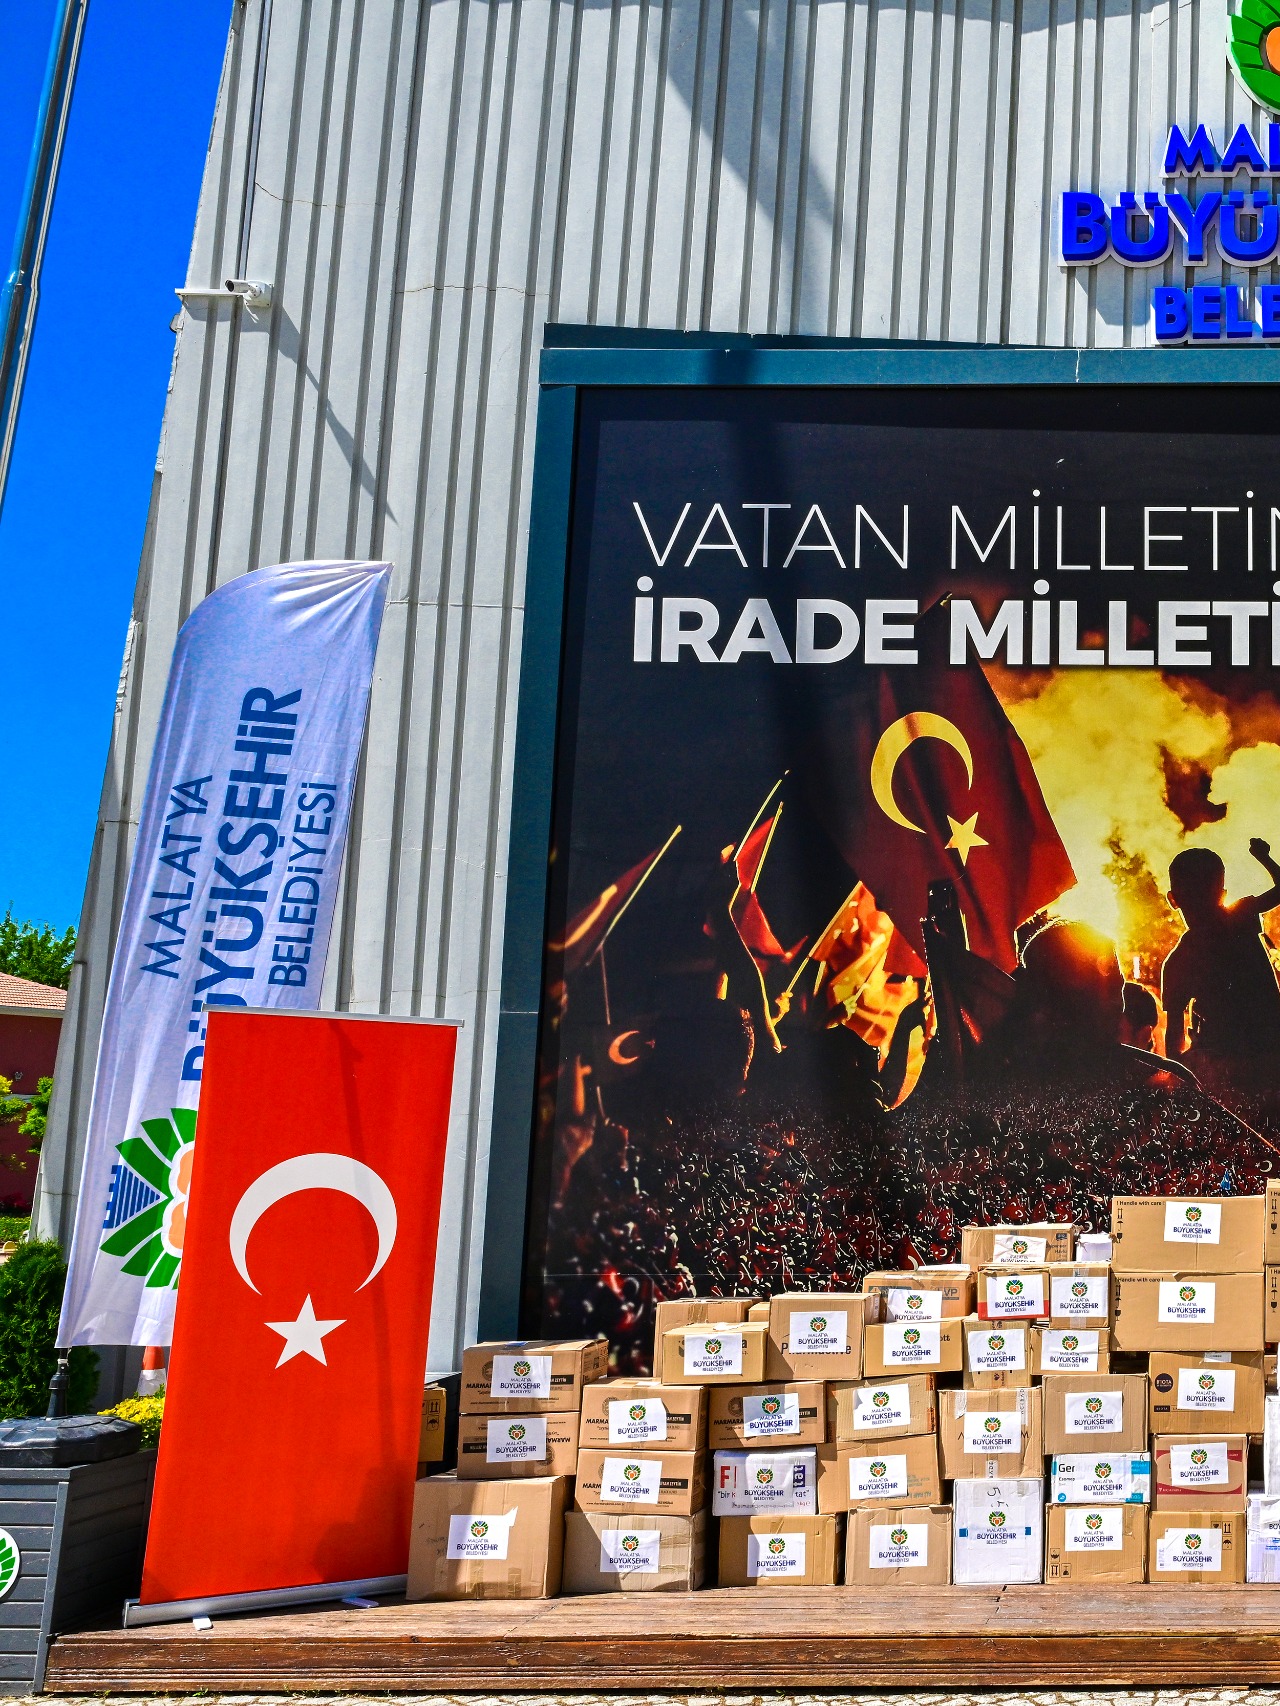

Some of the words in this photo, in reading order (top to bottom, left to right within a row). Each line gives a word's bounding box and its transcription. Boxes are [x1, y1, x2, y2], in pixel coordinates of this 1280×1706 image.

[632, 502, 909, 569] VATAN
[632, 576, 918, 665] İRADE
[139, 774, 213, 979] MALATYA
[268, 782, 337, 987] BELEDİYESİ
[995, 1300, 1035, 1308] BÜYÜKŞEHİR
[495, 1445, 537, 1454] BÜYÜKŞEHİR
[749, 1419, 793, 1430] BÜYÜKŞEHİR
